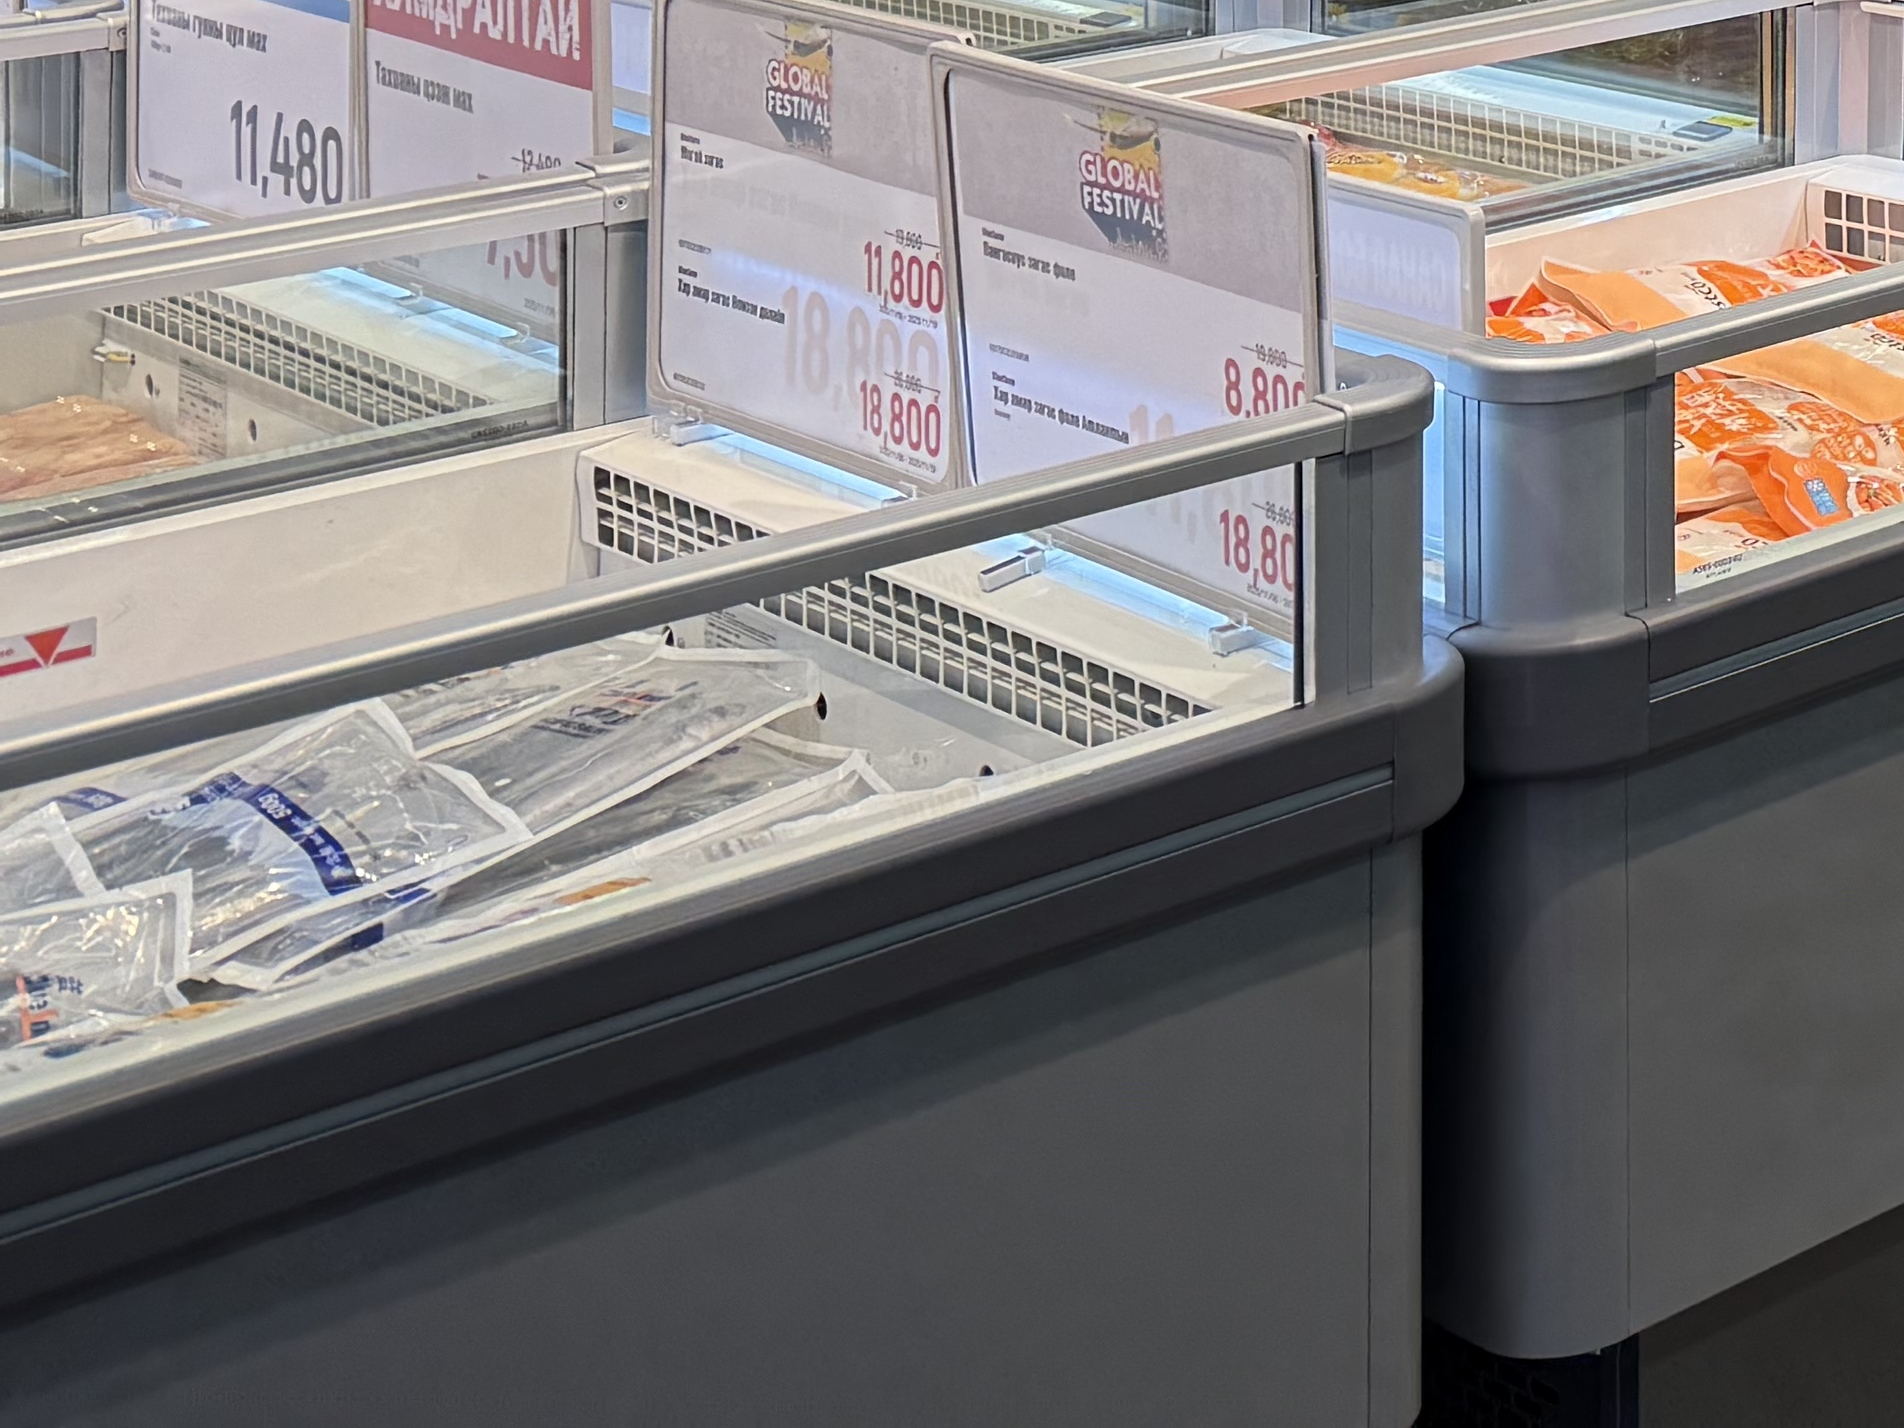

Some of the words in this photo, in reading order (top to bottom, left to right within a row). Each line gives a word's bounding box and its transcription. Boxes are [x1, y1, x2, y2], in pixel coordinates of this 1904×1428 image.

[765, 55, 831, 101] GLOBAL
[765, 88, 833, 134] FESTIVAL
[229, 98, 344, 205] 11,480
[1078, 148, 1162, 202] GLOBAL
[1080, 182, 1166, 230] FESTIVAL
[863, 240, 945, 315] 11,800
[859, 379, 943, 459] 18,800
[1219, 508, 1296, 591] 18,80
